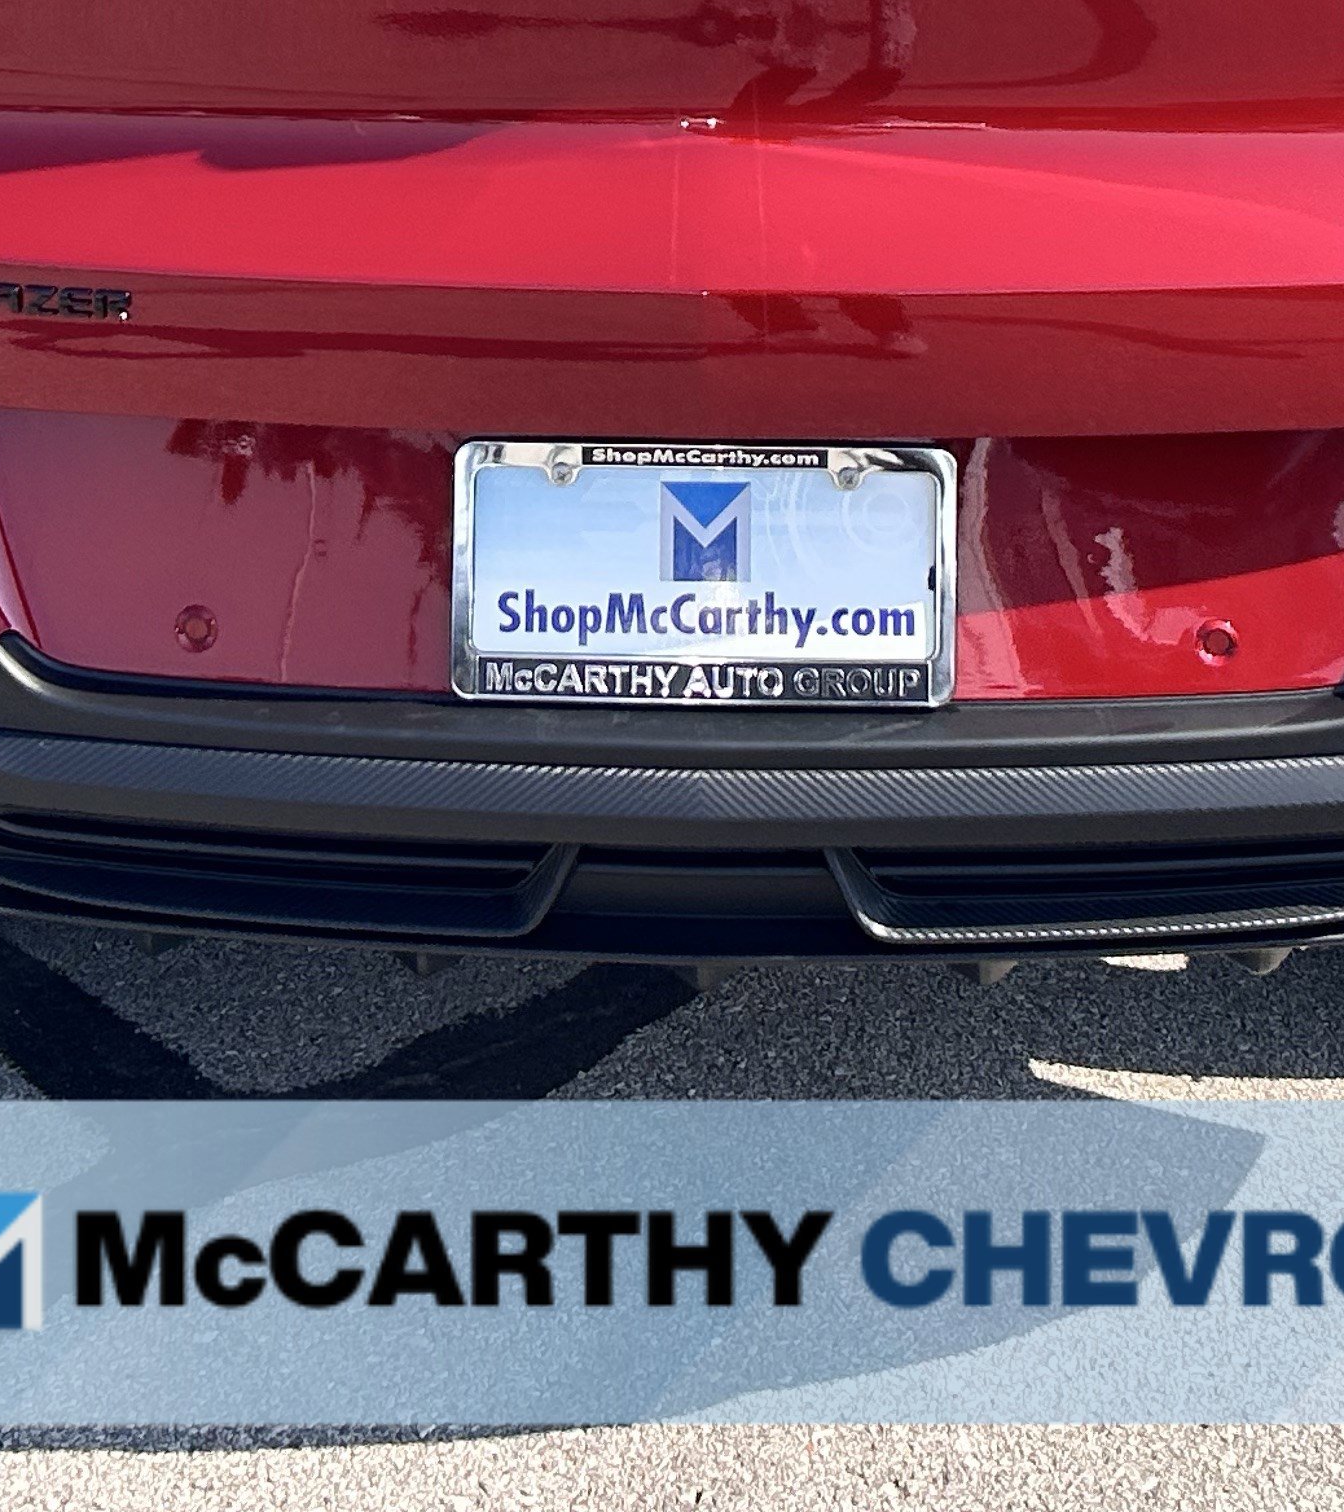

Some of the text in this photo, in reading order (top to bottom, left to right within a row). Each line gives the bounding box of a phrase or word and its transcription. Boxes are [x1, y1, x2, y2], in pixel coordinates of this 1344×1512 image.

[592, 447, 820, 467] ShopMcCarthy.com
[497, 589, 916, 648] ShopMcCarthy.com
[485, 662, 921, 698] McCARTHY AUTO GROUP
